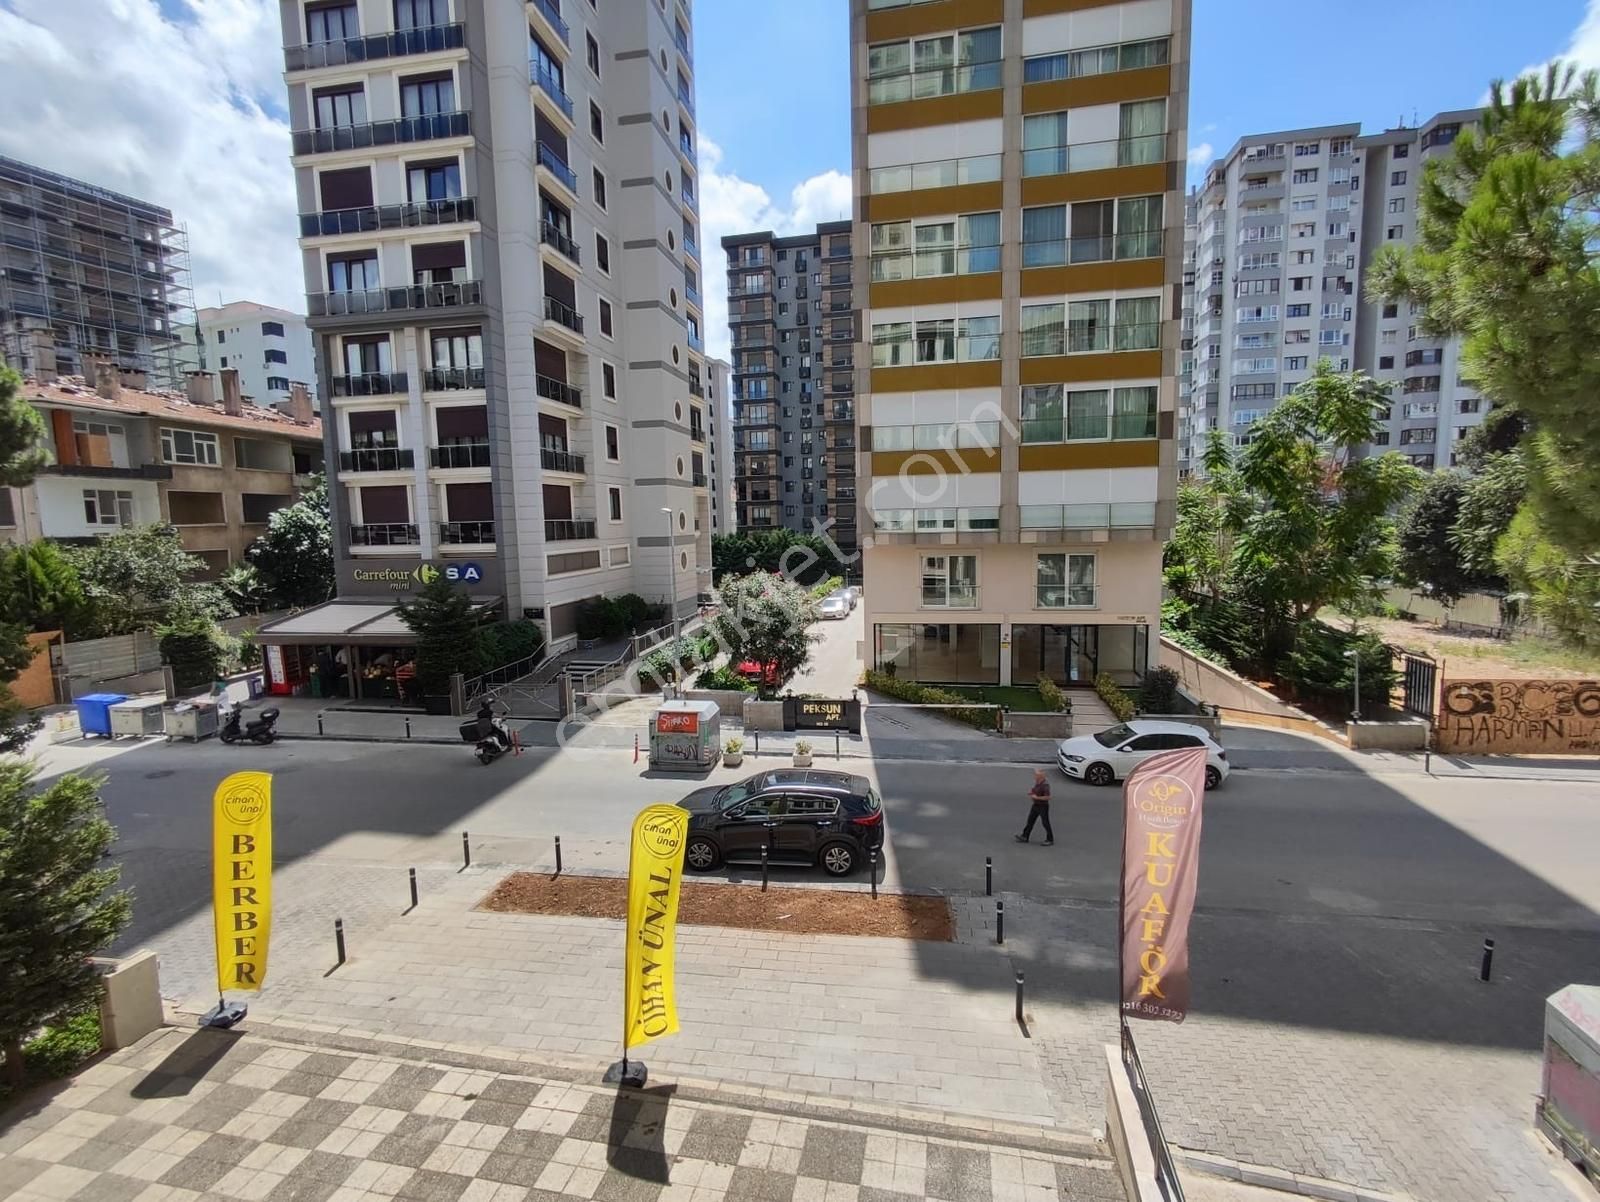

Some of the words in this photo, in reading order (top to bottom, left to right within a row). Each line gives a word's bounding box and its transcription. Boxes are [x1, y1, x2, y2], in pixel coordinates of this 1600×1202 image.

[354, 568, 410, 581] Carrefour
[390, 581, 410, 592] mini
[803, 703, 841, 714] PEKSUN
[825, 713, 842, 721] APT.
[1140, 800, 1187, 817] Origin
[231, 834, 260, 984] BERBER
[638, 866, 672, 950] ÜNAL
[1138, 831, 1177, 999] KUAFÖR
